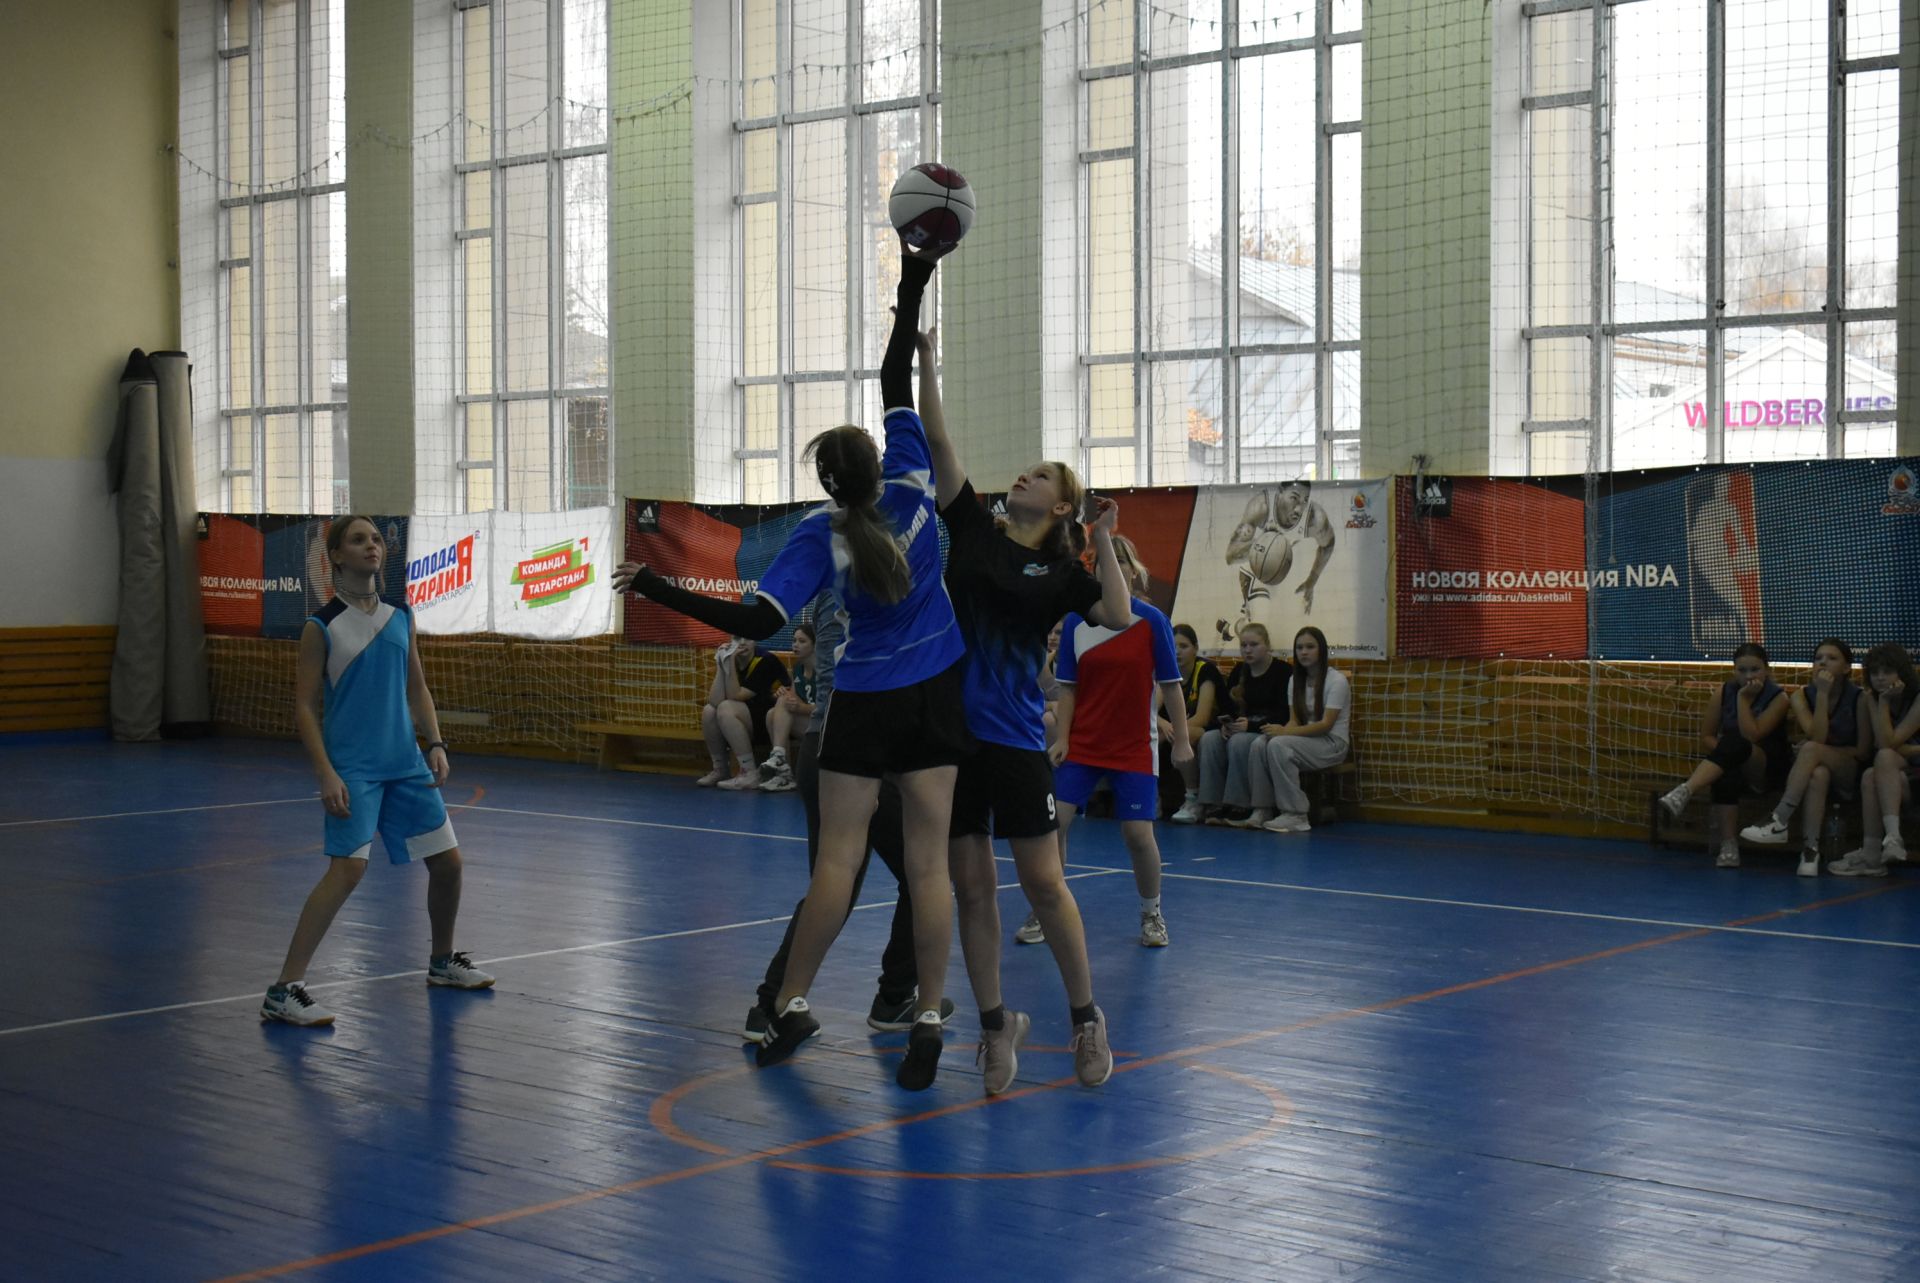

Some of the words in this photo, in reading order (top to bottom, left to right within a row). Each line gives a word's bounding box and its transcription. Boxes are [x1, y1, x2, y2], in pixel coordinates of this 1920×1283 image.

[522, 554, 567, 576] КОМАНДА
[1626, 564, 1679, 588] NBA
[279, 576, 303, 592] NBA
[528, 570, 585, 595] ТАТАРСТАНА
[1046, 792, 1056, 821] 9
